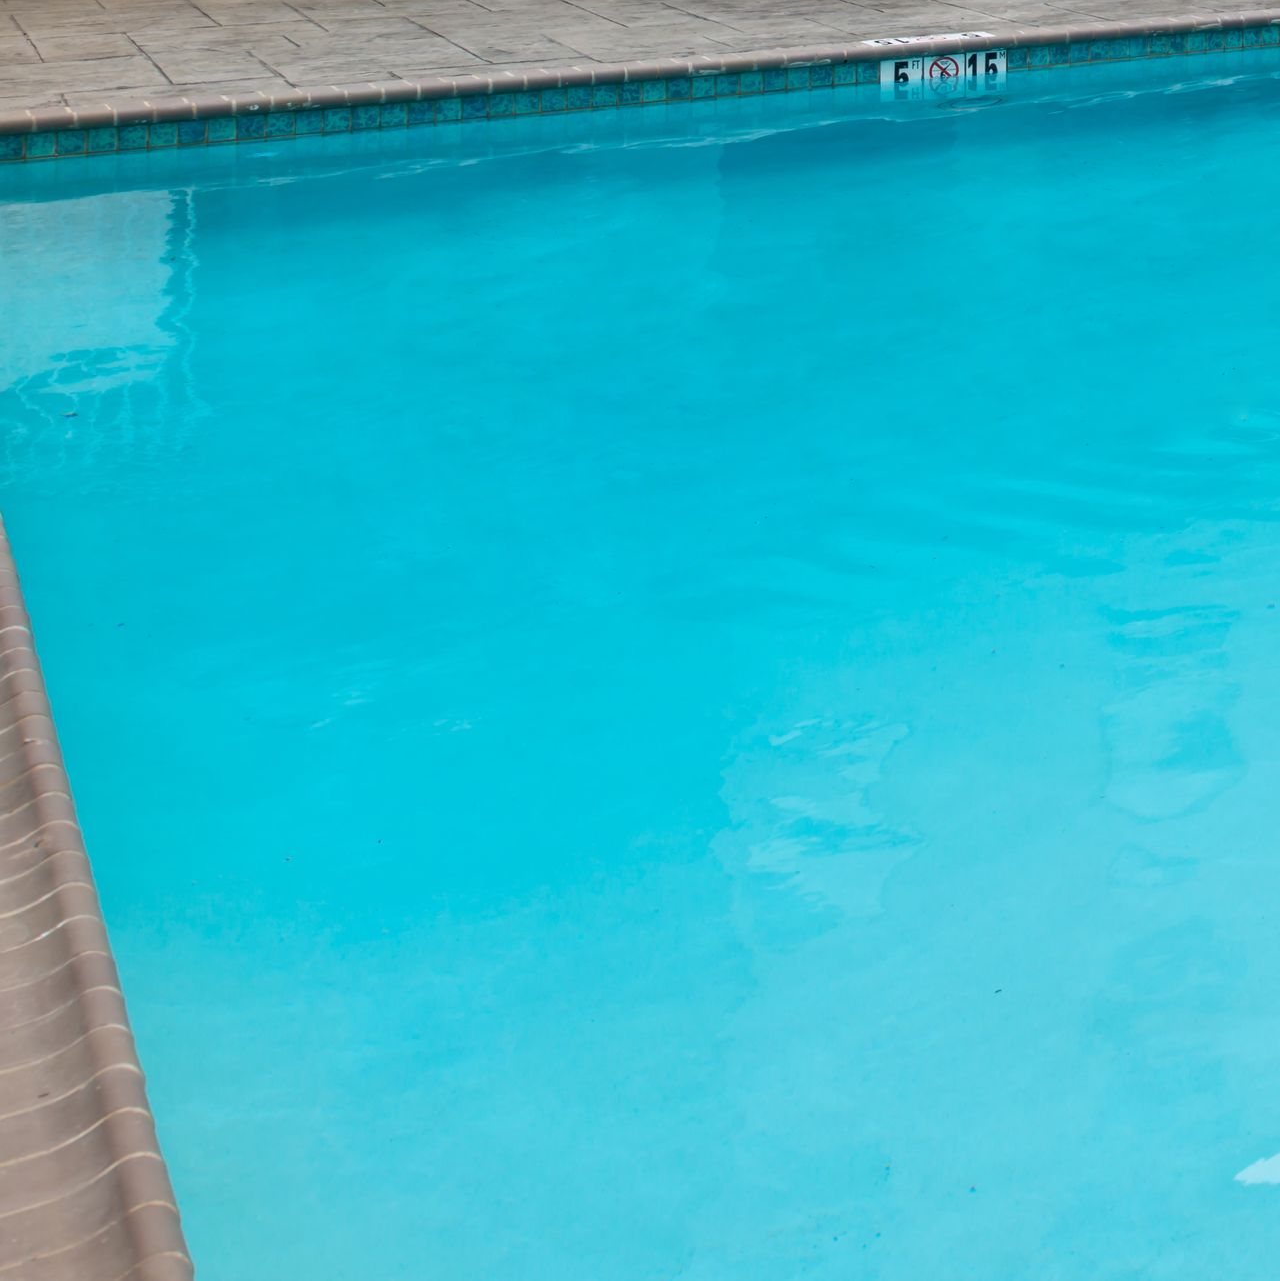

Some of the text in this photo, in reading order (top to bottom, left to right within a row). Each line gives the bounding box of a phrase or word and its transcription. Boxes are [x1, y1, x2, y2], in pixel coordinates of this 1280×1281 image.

[894, 61, 909, 83] 5
[912, 60, 920, 69] FT
[999, 51, 1006, 59] M
